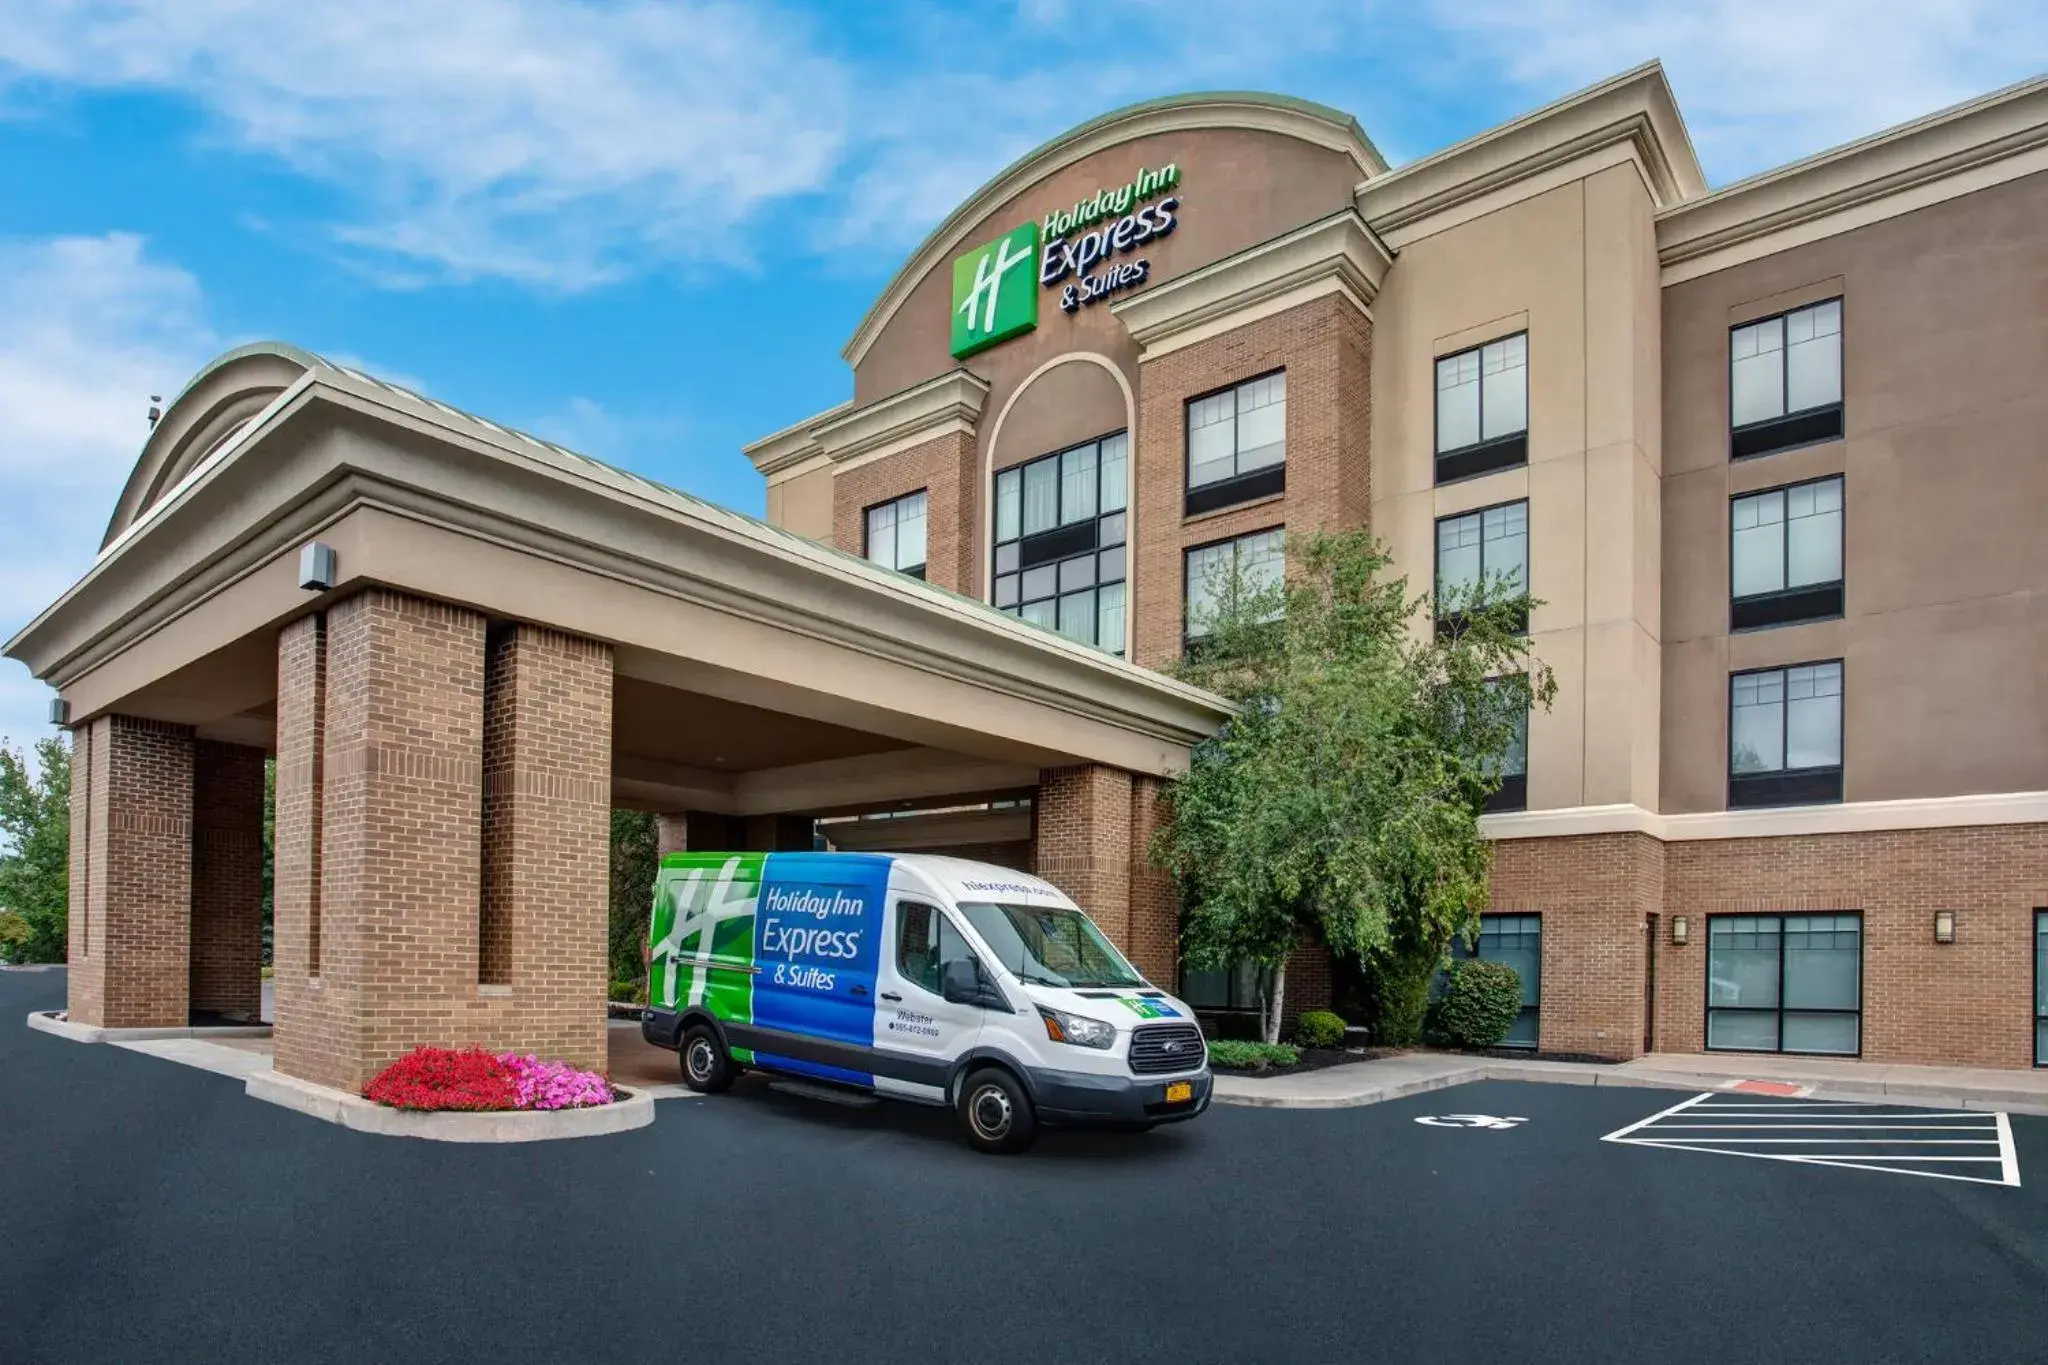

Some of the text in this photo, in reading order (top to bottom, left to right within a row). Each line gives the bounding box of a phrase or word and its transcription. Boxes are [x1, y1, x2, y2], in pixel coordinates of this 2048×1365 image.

[1041, 163, 1178, 243] Holiday Inn
[1040, 197, 1177, 284] Express
[1060, 257, 1147, 311] & Suites
[766, 886, 864, 920] Holiday Inn
[763, 918, 860, 962] Express
[773, 963, 835, 991] & Suites
